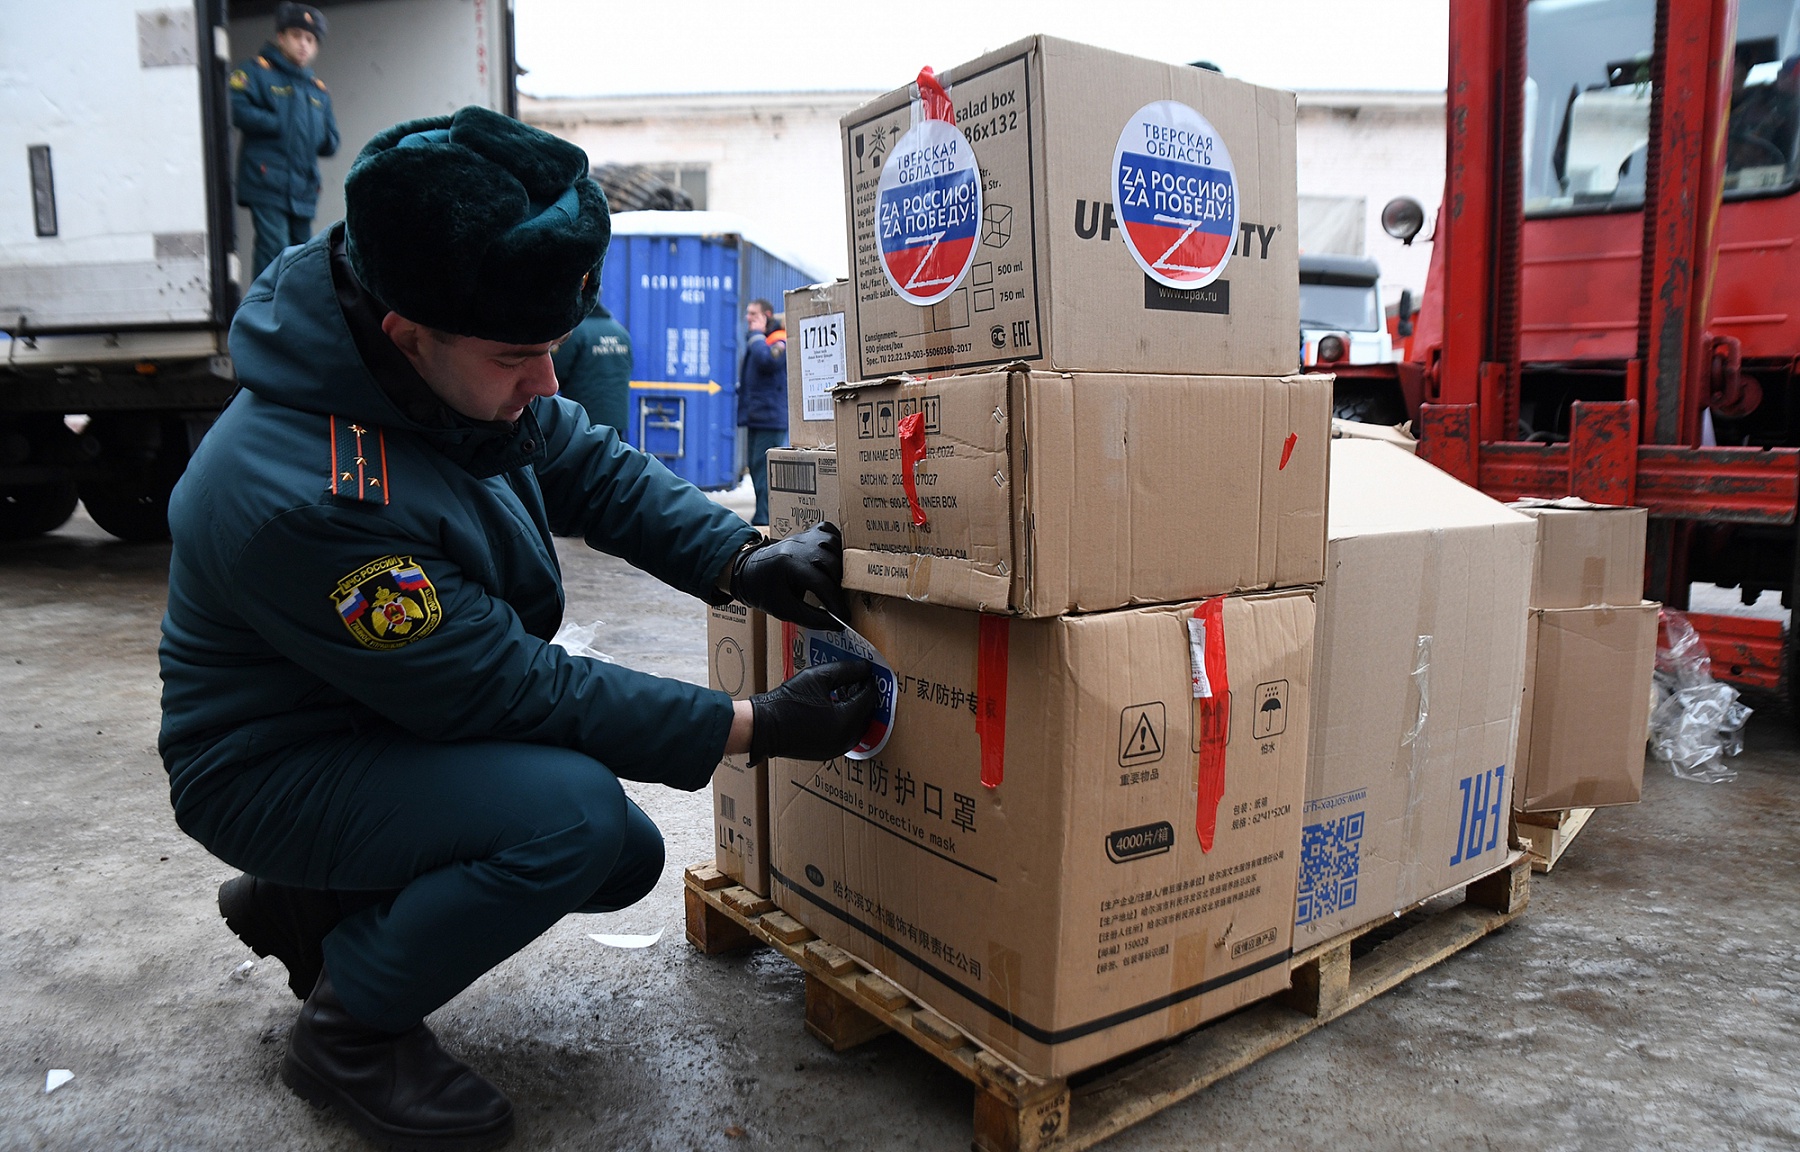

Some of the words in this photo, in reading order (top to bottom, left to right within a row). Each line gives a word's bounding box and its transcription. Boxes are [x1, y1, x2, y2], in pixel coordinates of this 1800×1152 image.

[956, 101, 987, 123] salad
[992, 90, 1015, 110] box
[1143, 123, 1213, 151] ТВЕРСКАЯ
[897, 140, 956, 169] ТВЕРСКАЯ
[1146, 140, 1211, 165] ОБЛАСТЬ
[899, 158, 955, 184] ОБЛАСТЬ
[989, 180, 1001, 189] Str.
[1152, 171, 1232, 201] РОССИЮ!
[903, 182, 975, 216] РОССИЮ!
[1155, 191, 1232, 221] ПОБЕДУ!
[858, 207, 870, 217] Legal
[906, 202, 975, 233] ПОБЕДУ!
[858, 221, 865, 229] De
[859, 244, 871, 254] Sales
[1152, 214, 1212, 273] Z
[904, 231, 954, 289] Z
[997, 263, 1011, 276] 500
[1013, 261, 1023, 273] ml
[860, 267, 878, 278] e-mail:
[861, 292, 879, 303] e-mail:
[1000, 290, 1013, 302] 750
[1015, 288, 1025, 300] ml
[1158, 286, 1217, 303] www.upax.ru
[804, 323, 837, 349] 17115
[865, 330, 897, 343] Consignment:
[866, 345, 875, 354] 500
[877, 342, 903, 354] pieces/box
[866, 357, 879, 367] Spec.
[880, 355, 886, 363] TU
[859, 451, 871, 462] ITEM
[873, 450, 888, 461] NAME
[860, 474, 877, 486] BATCH
[878, 474, 888, 486] NO:
[922, 496, 941, 508] INNER
[943, 496, 958, 508] BOX
[342, 575, 361, 590] МЧС
[360, 557, 398, 579] РОССИИ
[868, 564, 883, 576] MADE
[885, 565, 890, 577] IN
[891, 566, 908, 579] CHINA
[827, 632, 873, 660] ОБЛАСТЬ
[1261, 742, 1275, 755] 怕水
[1119, 768, 1159, 787] 重要物品
[815, 774, 864, 809] Disposable
[868, 803, 924, 839] protective
[930, 831, 956, 853] mask
[1116, 826, 1168, 851] 4000片/箱
